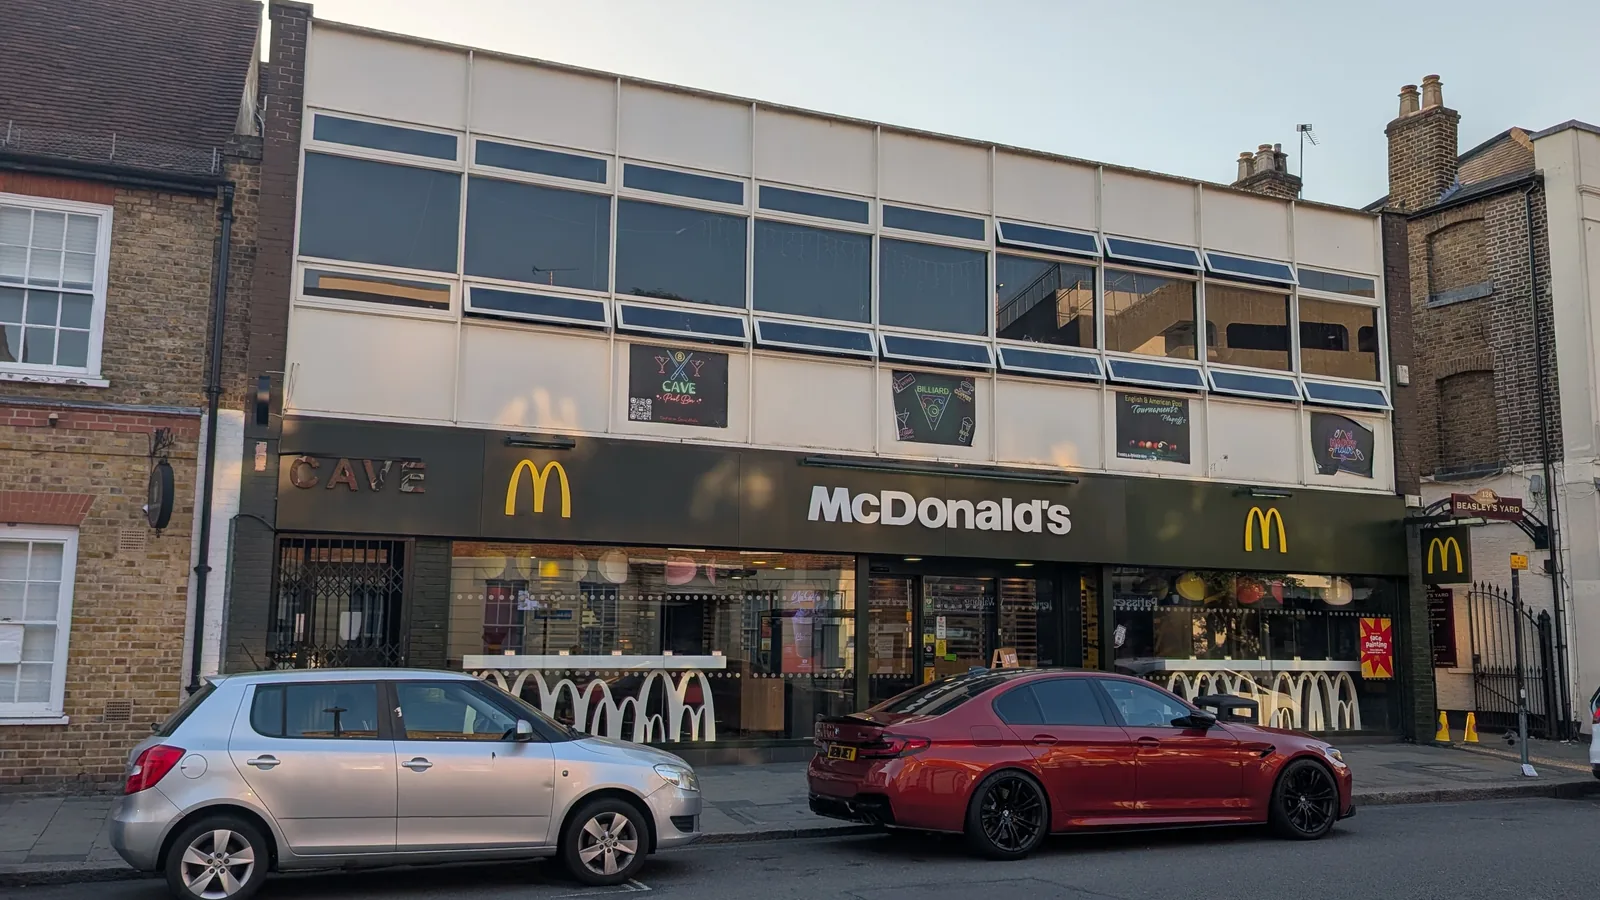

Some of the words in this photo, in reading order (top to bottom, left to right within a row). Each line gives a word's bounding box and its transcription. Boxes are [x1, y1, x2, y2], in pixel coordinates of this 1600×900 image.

[662, 381, 696, 394] CAVE
[916, 385, 950, 395] BILLIARD
[663, 393, 680, 404] Pool
[1124, 395, 1144, 404] English
[1149, 398, 1172, 406] American
[1172, 400, 1183, 408] Pool
[1131, 403, 1179, 414] Tournaments
[289, 456, 426, 494] CAVE
[807, 485, 1072, 536] McDonald's
[1456, 502, 1498, 512] BEASLEY'S
[1499, 505, 1520, 514] YARD
